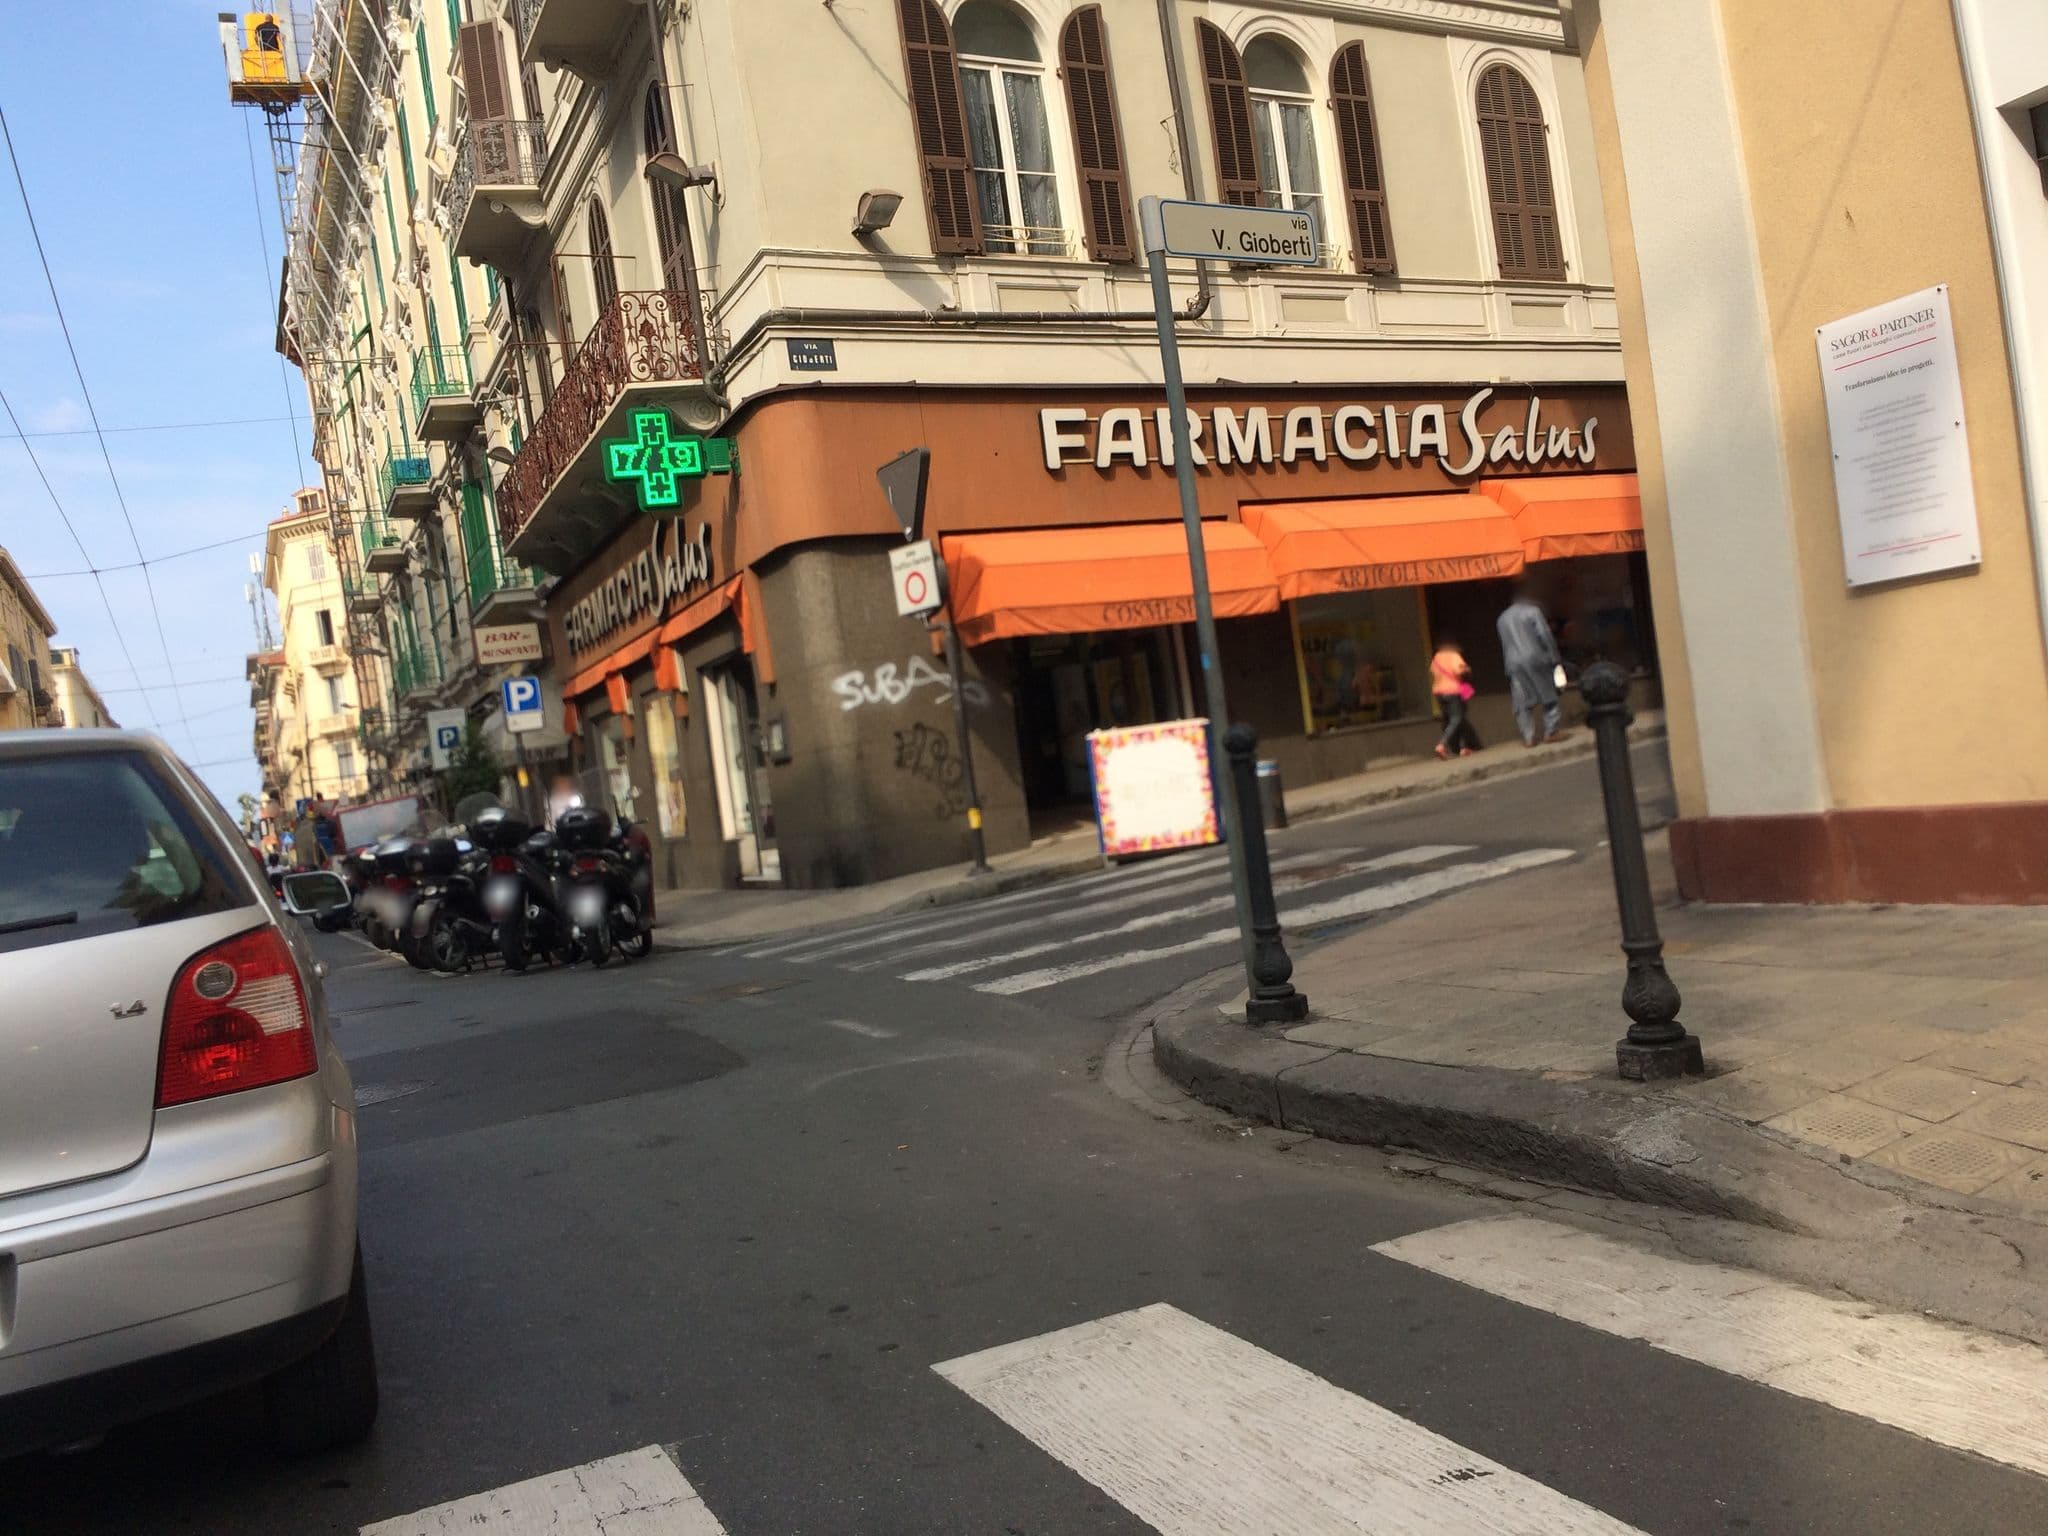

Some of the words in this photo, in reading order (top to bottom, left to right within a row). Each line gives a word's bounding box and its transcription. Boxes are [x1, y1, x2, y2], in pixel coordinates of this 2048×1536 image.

[1291, 217, 1308, 230] via
[1212, 229, 1231, 251] V.
[1239, 231, 1312, 256] Gioberti
[1830, 328, 1870, 351] SAGOR
[1871, 328, 1878, 338] &
[1880, 308, 1935, 336] PARTNER
[1040, 403, 1448, 469] FARMACIA
[1438, 387, 1598, 475] Salus
[564, 550, 653, 653] FARMACIA
[650, 515, 709, 618] Salus
[1337, 564, 1420, 588] ARTICOLI
[508, 680, 535, 712] P
[441, 729, 456, 746] P
